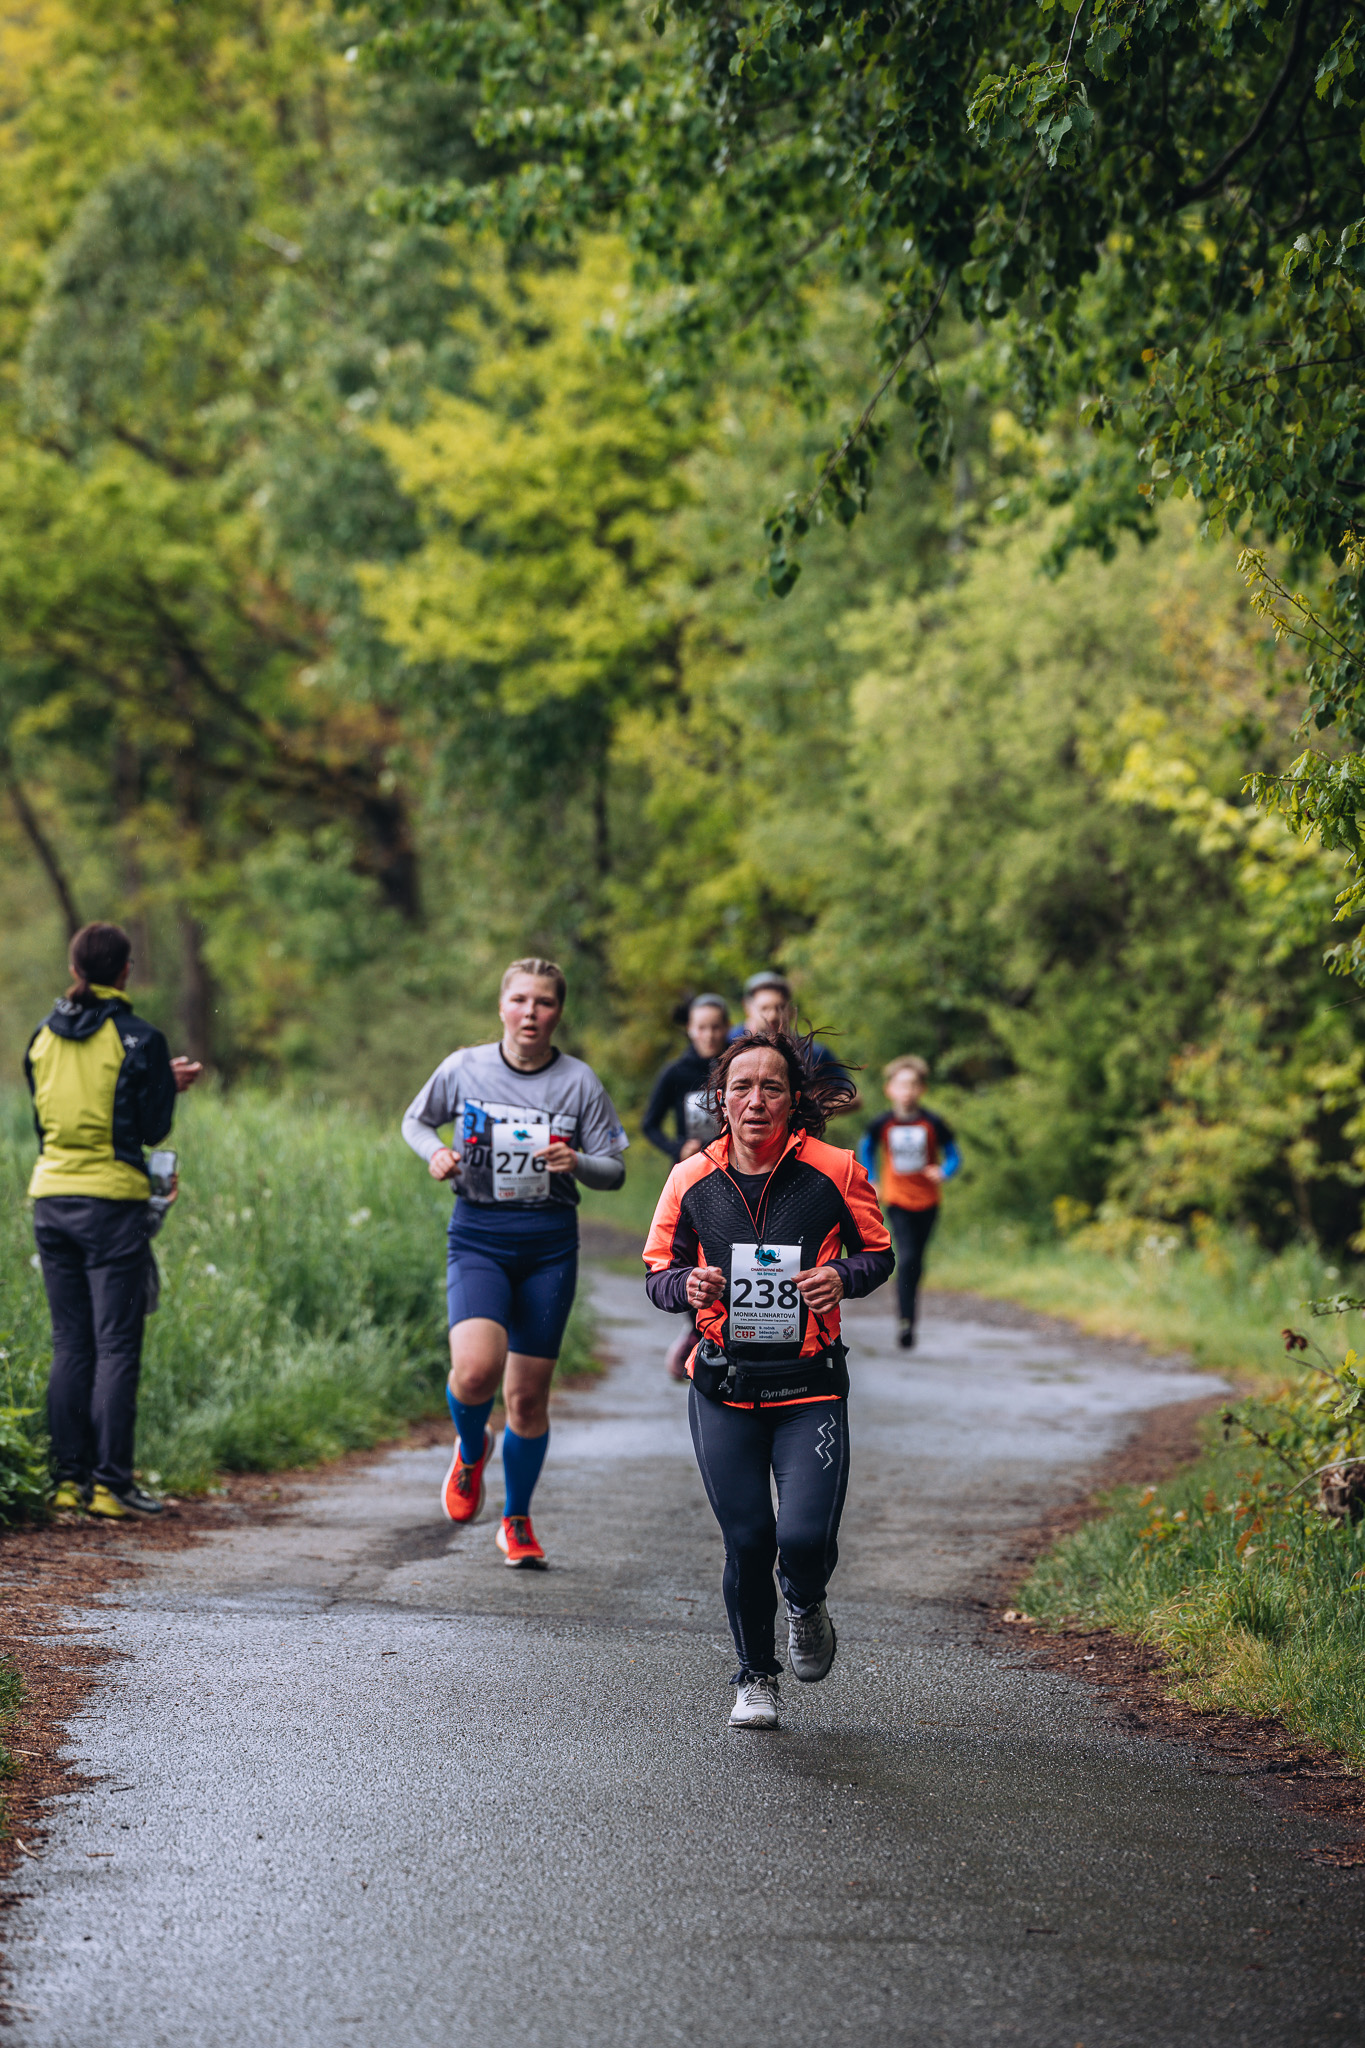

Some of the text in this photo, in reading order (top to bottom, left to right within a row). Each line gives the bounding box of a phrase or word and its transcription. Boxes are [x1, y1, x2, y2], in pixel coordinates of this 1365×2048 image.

[496, 1152, 546, 1174] 276
[732, 1278, 798, 1309] 238
[735, 1330, 756, 1339] CUP
[760, 1386, 808, 1399] GymBeam
